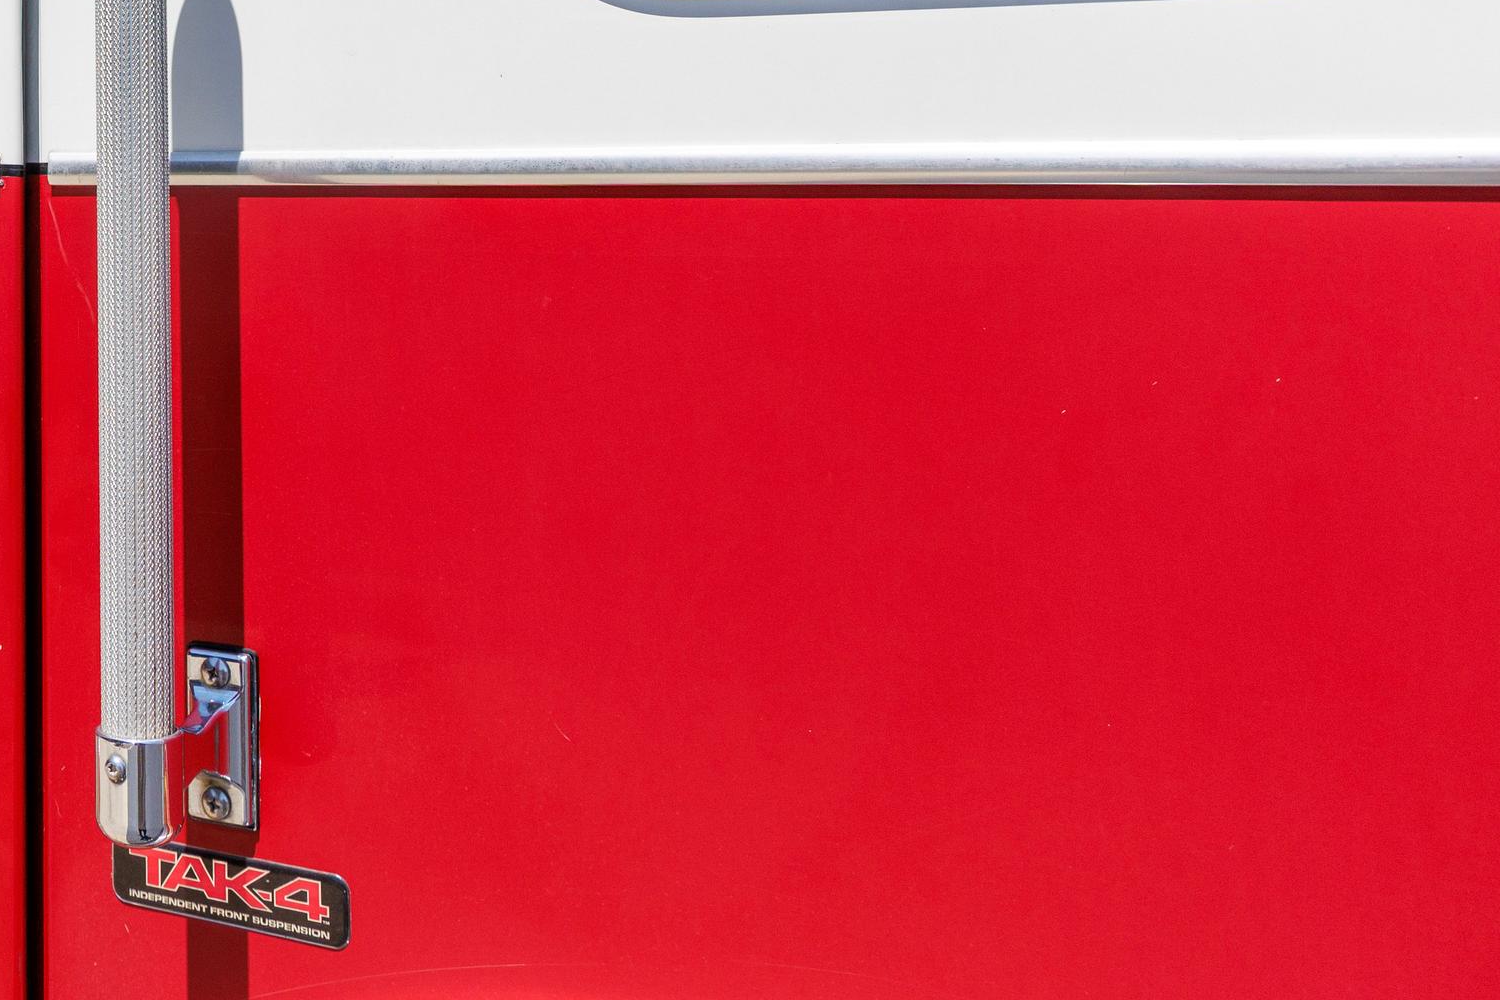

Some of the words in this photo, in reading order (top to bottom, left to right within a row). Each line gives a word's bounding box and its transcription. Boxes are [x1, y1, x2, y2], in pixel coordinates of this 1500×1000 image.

[128, 847, 330, 924] TAK-4
[129, 888, 208, 914] INDEPENDENT
[210, 906, 250, 922] FRONT
[252, 916, 330, 940] SUSPENSION
